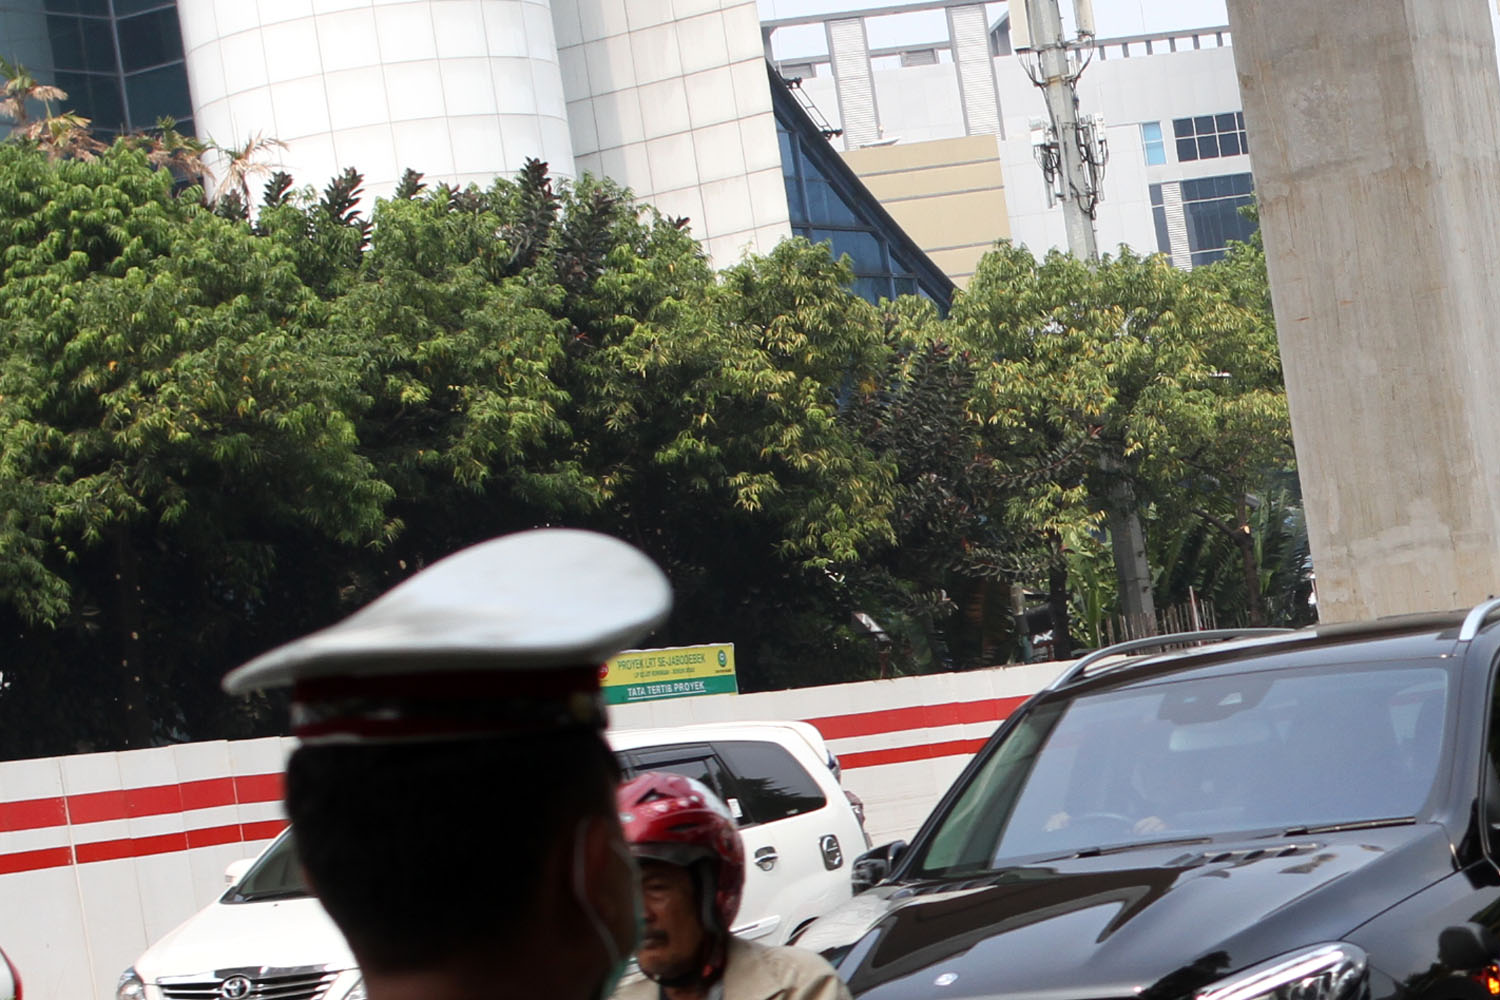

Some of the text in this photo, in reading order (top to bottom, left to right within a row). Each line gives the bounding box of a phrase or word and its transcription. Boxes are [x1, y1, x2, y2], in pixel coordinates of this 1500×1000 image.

[617, 660, 644, 670] PROYEK
[645, 657, 656, 668] LRT
[627, 681, 704, 697] TATA TERTIB PROYEK
